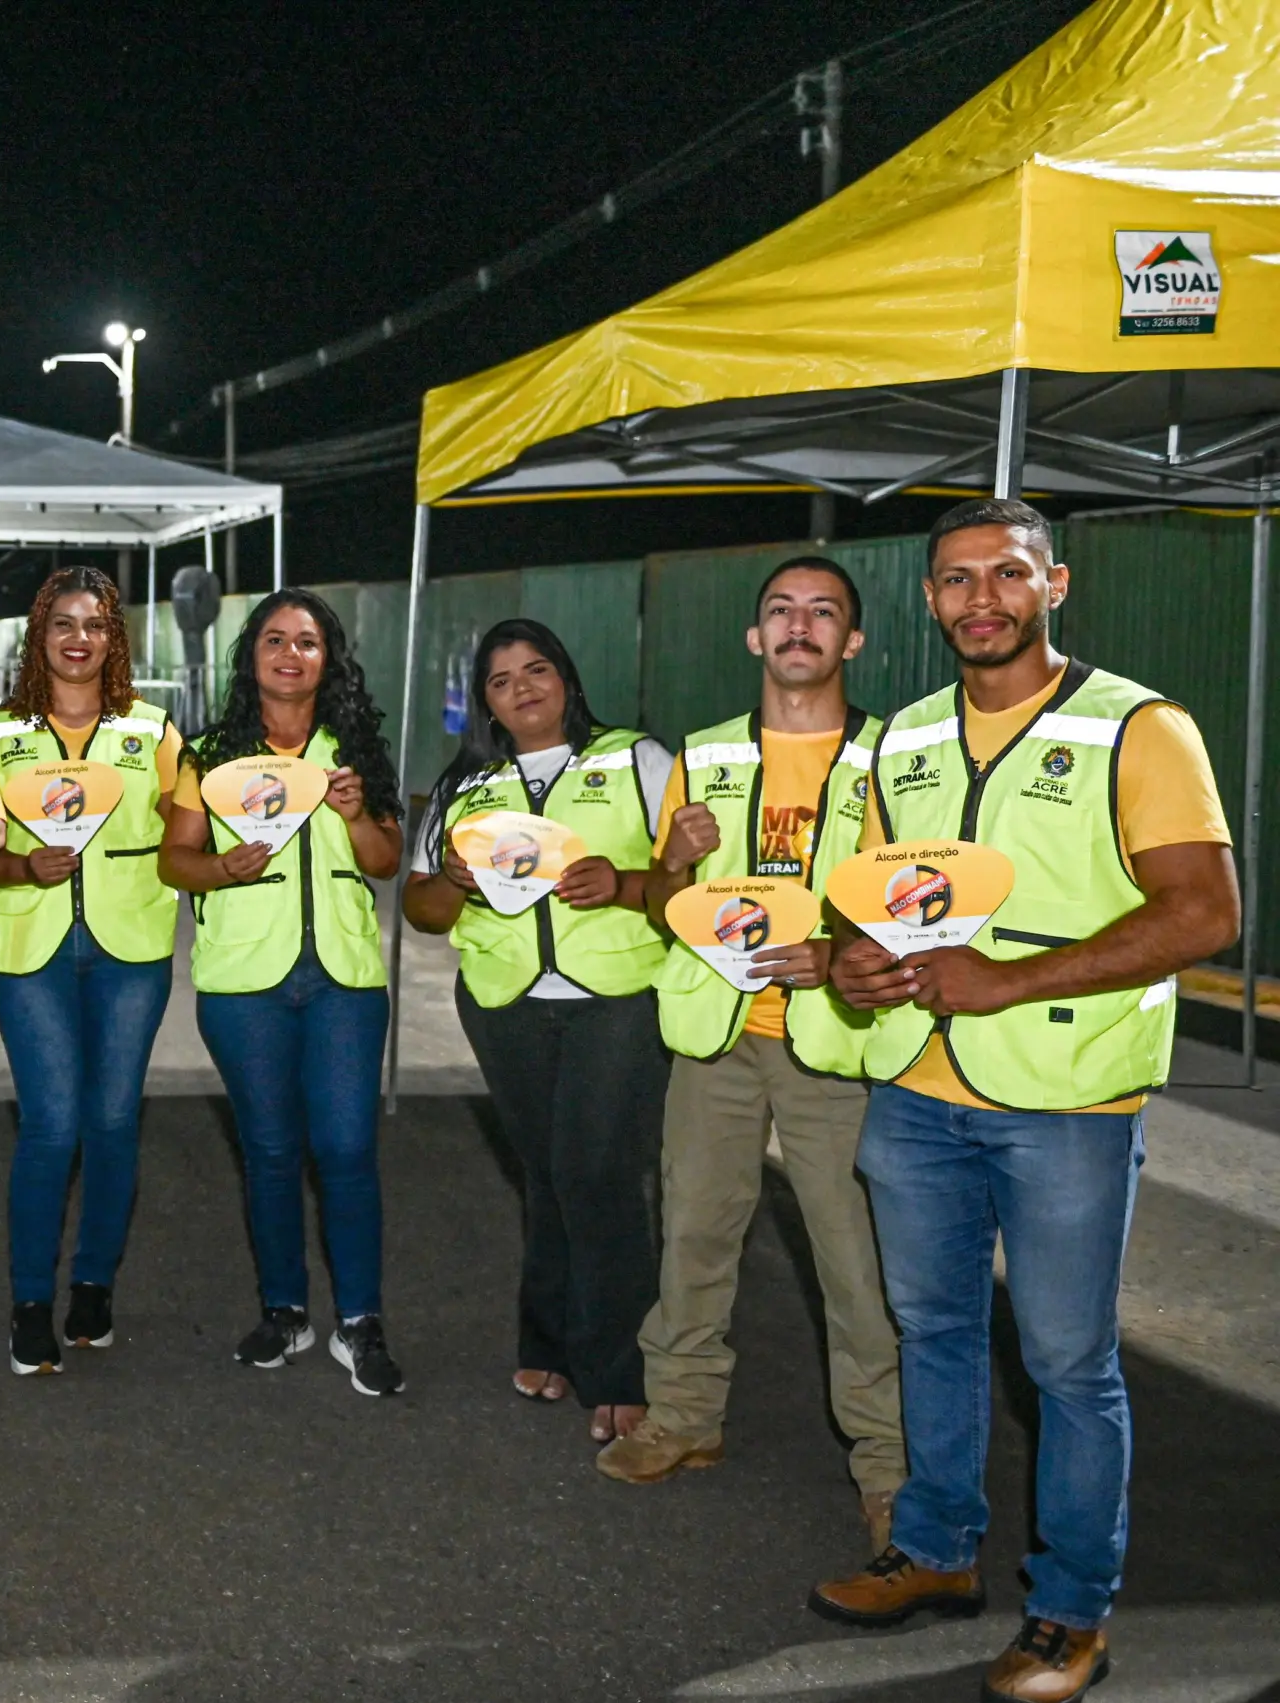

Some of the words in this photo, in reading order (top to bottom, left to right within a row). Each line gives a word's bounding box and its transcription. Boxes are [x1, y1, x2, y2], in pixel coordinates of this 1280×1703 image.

[1124, 272, 1219, 294] VISUAL
[1031, 781, 1068, 795] ACRE
[875, 849, 907, 862] Álcool
[919, 847, 959, 860] direção
[706, 884, 732, 893] Álcool
[743, 883, 775, 894] direção
[890, 901, 906, 913] NÃO
[906, 875, 946, 903] COMBINAM!
